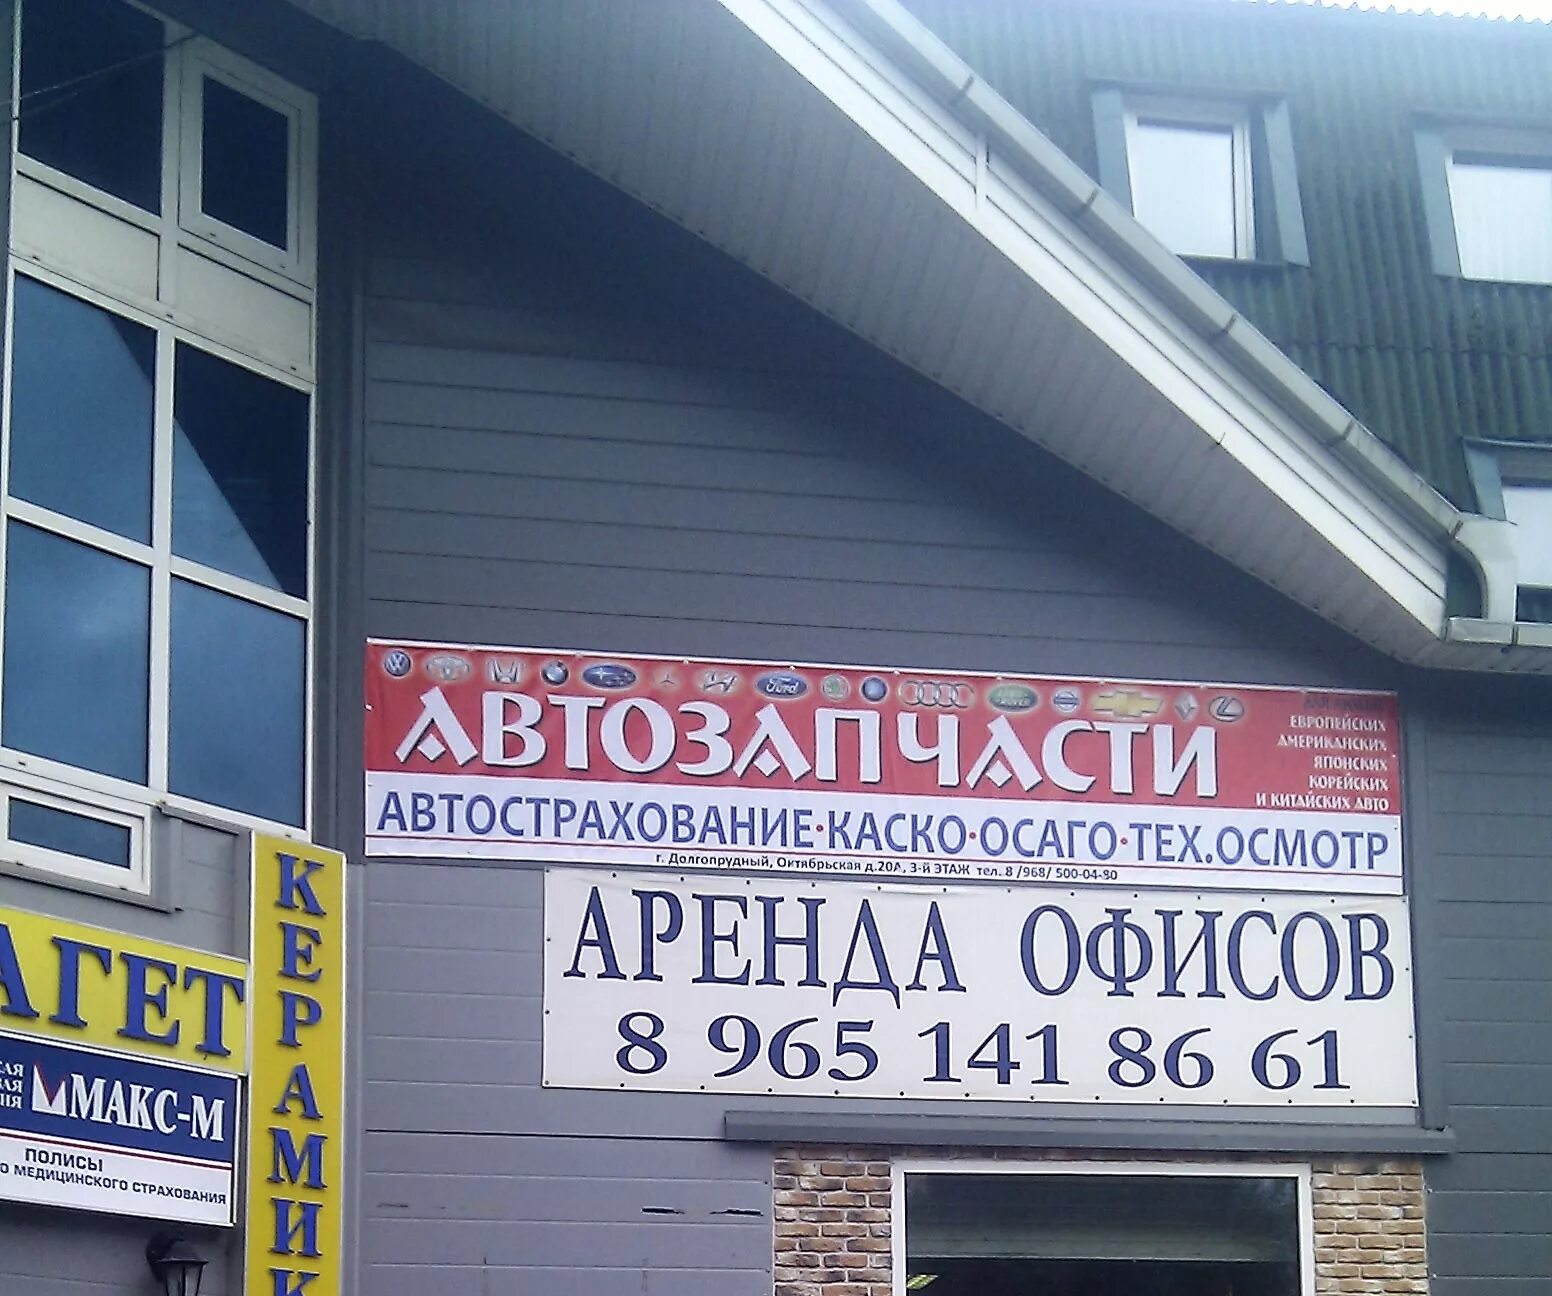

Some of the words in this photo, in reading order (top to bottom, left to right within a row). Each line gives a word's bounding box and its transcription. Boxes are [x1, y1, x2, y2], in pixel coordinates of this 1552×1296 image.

[1289, 713, 1387, 731] ЕВРОПЕЙСКИХ
[395, 686, 1218, 799] АВТОЗАПЧАСТИ
[1277, 734, 1387, 751] АМЕРИКАНСКИХ
[1314, 755, 1388, 771] ЯПОНСКИХ
[1308, 772, 1388, 791] КОРЕЙСКИХ
[1256, 792, 1266, 806] И
[1270, 791, 1350, 809] КИТАЙСКИХ
[1354, 797, 1389, 811] АВТО
[668, 853, 774, 868] Долгопрудный,
[777, 858, 861, 872] Октябрьская
[910, 862, 931, 874] 3-й
[934, 863, 970, 875] ЭТАЖ
[976, 866, 1001, 877] тел.
[1005, 866, 1013, 877] 8
[1016, 865, 1052, 879] /968/
[563, 885, 967, 1009] АРЕНДА
[1019, 904, 1395, 1001] ОФИСОВ
[616, 1011, 668, 1075] 8
[707, 1014, 879, 1082] 965
[917, 1021, 1070, 1085] 141
[1107, 1026, 1215, 1089] 86
[1251, 1028, 1351, 1090] 61
[69, 1072, 225, 1142] МАКС-М
[25, 1147, 103, 1171] ПОЛИСЫ
[14, 1164, 128, 1191] МЕДИЦИНСКОГО
[132, 1182, 226, 1204] СТРАХОВАНИЯ
